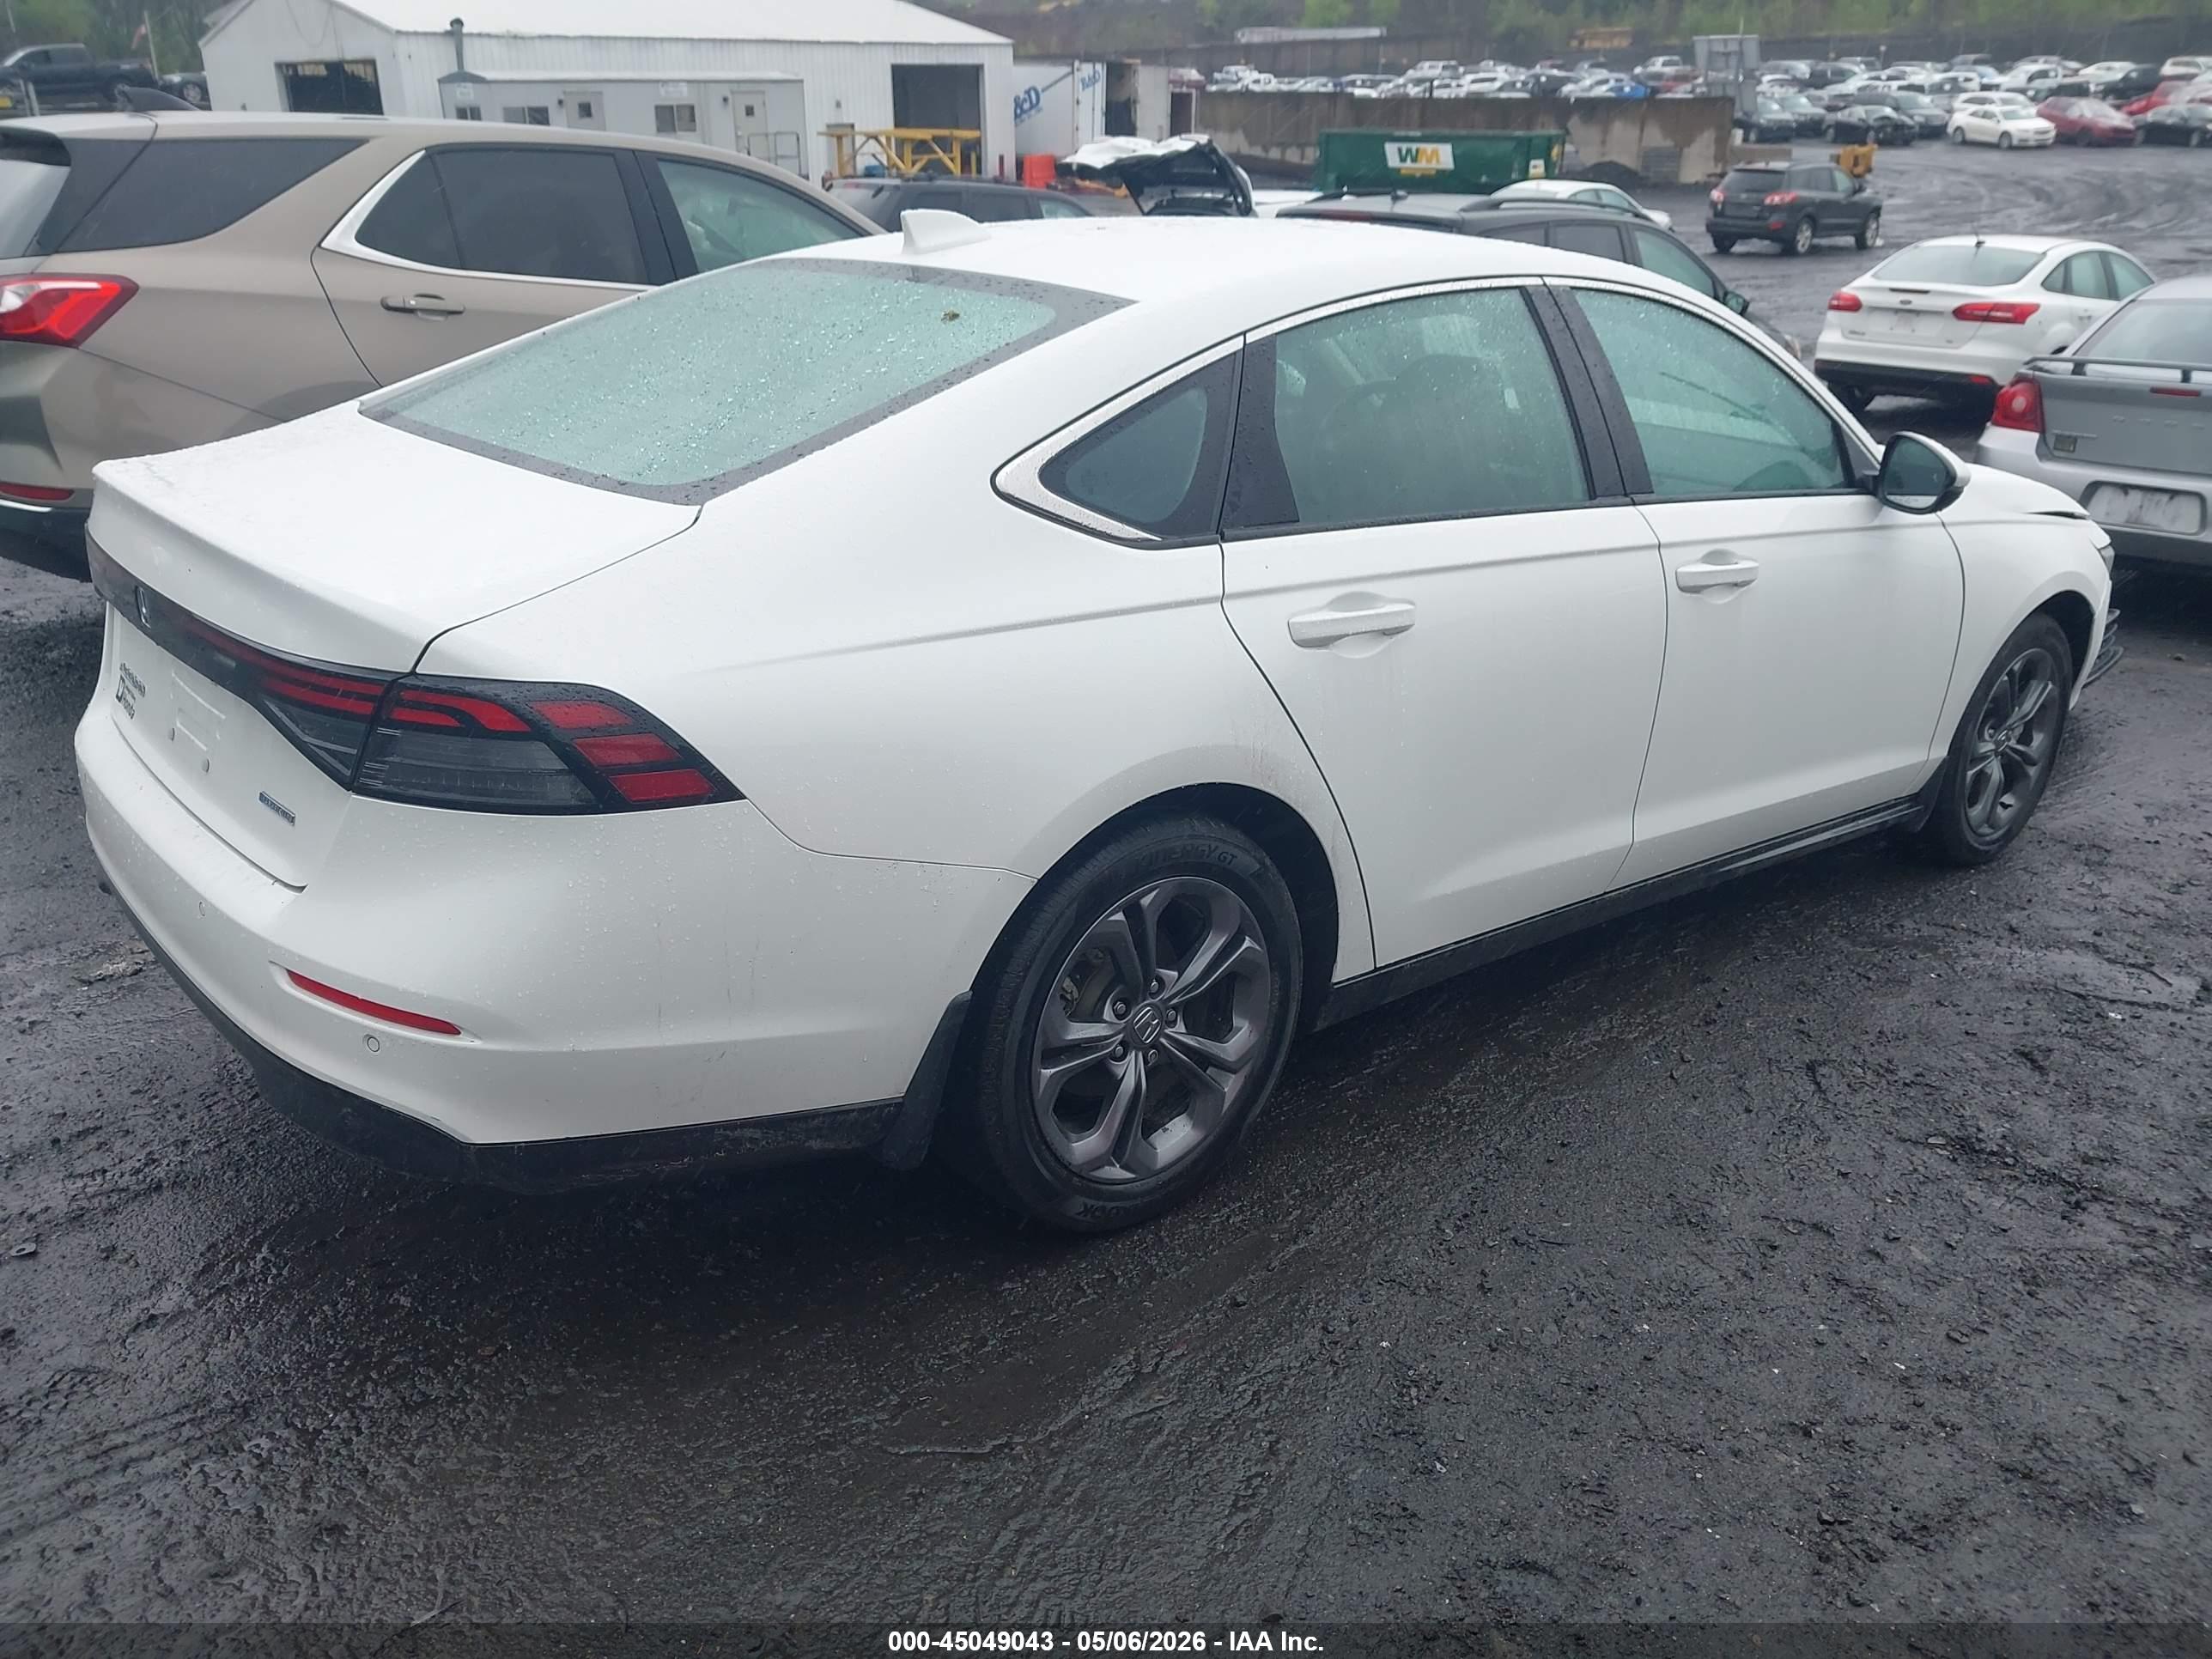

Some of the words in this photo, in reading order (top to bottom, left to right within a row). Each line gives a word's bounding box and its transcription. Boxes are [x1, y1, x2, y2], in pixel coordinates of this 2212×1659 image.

[1013, 86, 1041, 118] &D
[1397, 146, 1440, 164] WM
[1217, 851, 1237, 866] GT
